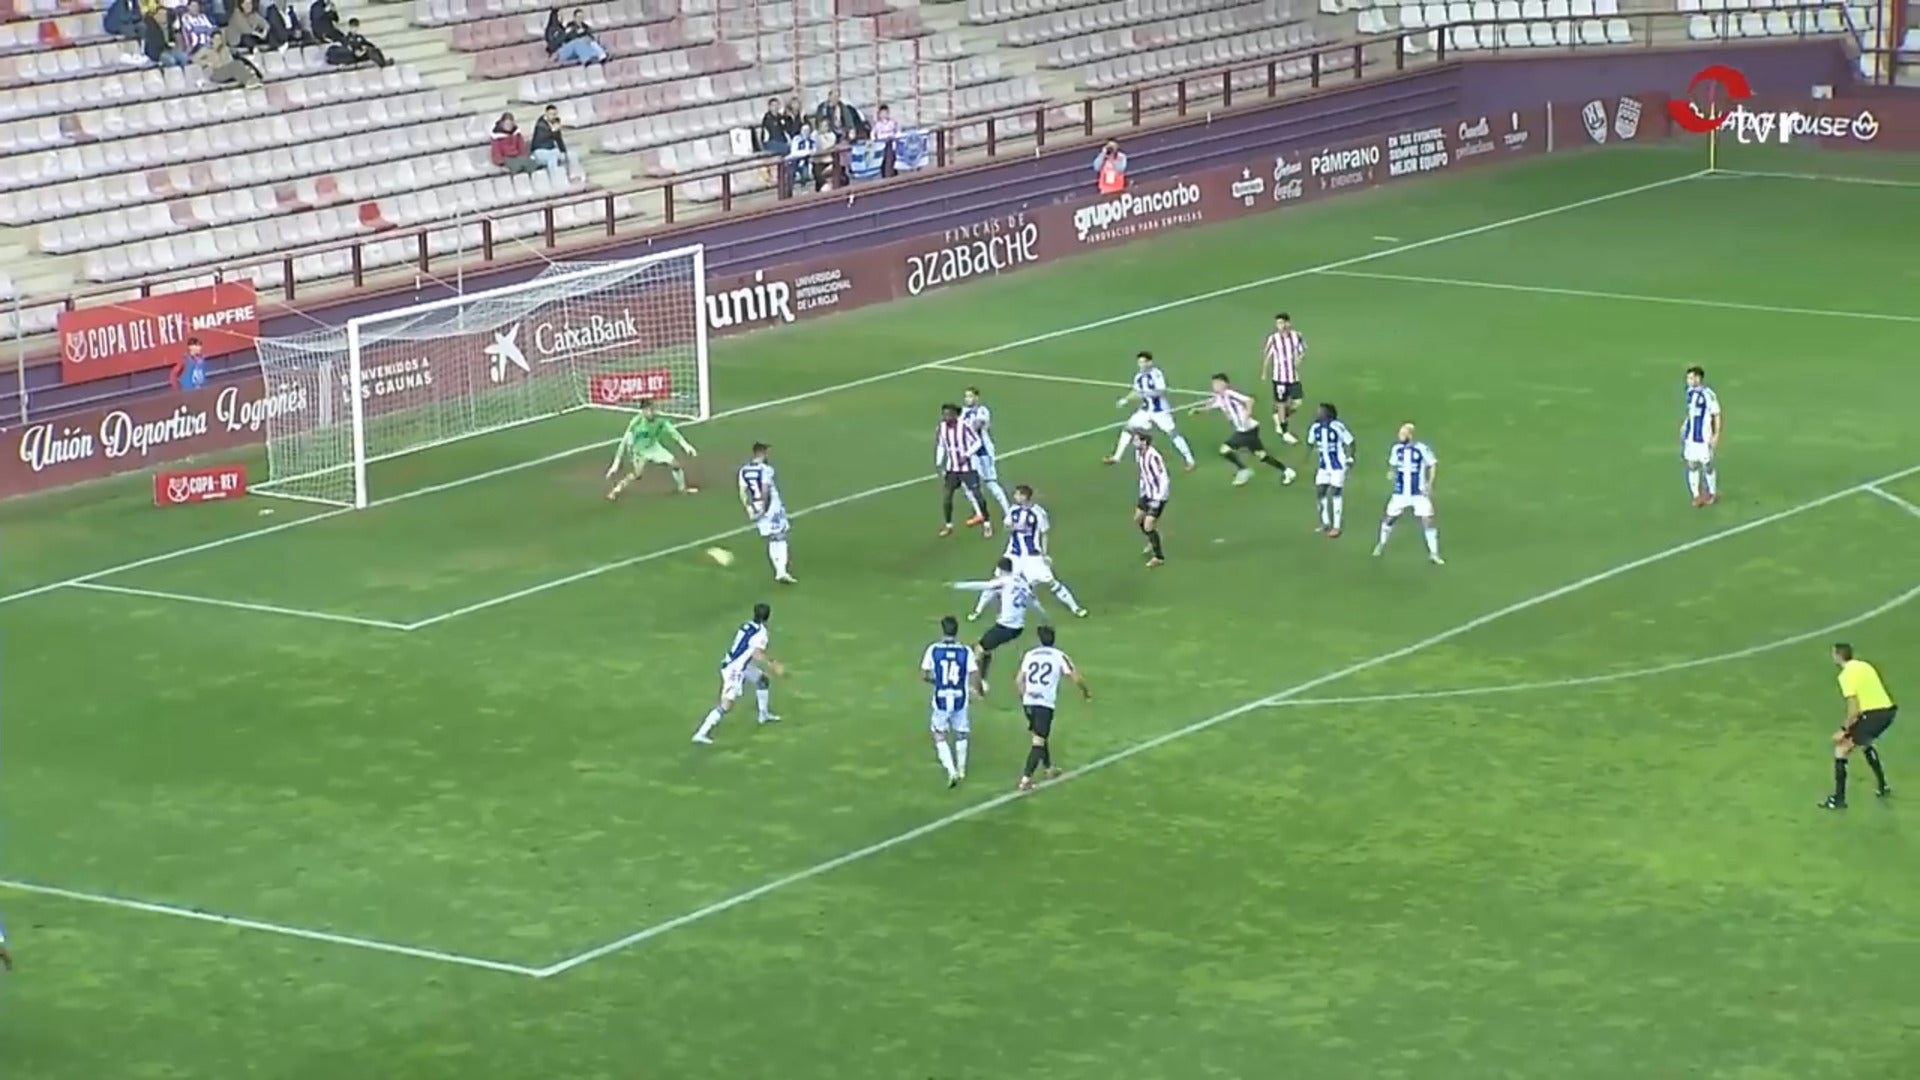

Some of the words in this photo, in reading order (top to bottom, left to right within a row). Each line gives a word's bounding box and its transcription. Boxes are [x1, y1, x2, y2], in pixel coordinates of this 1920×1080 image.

[1390, 157, 1418, 176] MEJOR
[1419, 152, 1448, 170] EQUIPO
[945, 218, 1001, 242] FINCAS
[1008, 212, 1025, 228] DE
[795, 268, 842, 288] UNIVERSIDAD
[796, 279, 852, 299] INTERNACIONAL
[807, 298, 817, 309] LA
[817, 294, 839, 306] RIOJA
[193, 305, 255, 331] MAPFRE
[535, 308, 638, 354] CaixaBank
[88, 323, 128, 360] COPA
[130, 318, 155, 352] DEL
[158, 312, 184, 345] REY
[421, 356, 430, 369] A
[342, 384, 370, 403] LS
[375, 370, 433, 396] GAUNAS
[20, 424, 93, 471] Unión
[100, 406, 207, 457] Deportiva
[216, 382, 307, 431] Logroñés
[190, 475, 214, 493] COPA
[220, 472, 239, 490] REY
[939, 659, 961, 687] 14
[1028, 660, 1054, 687] 22
